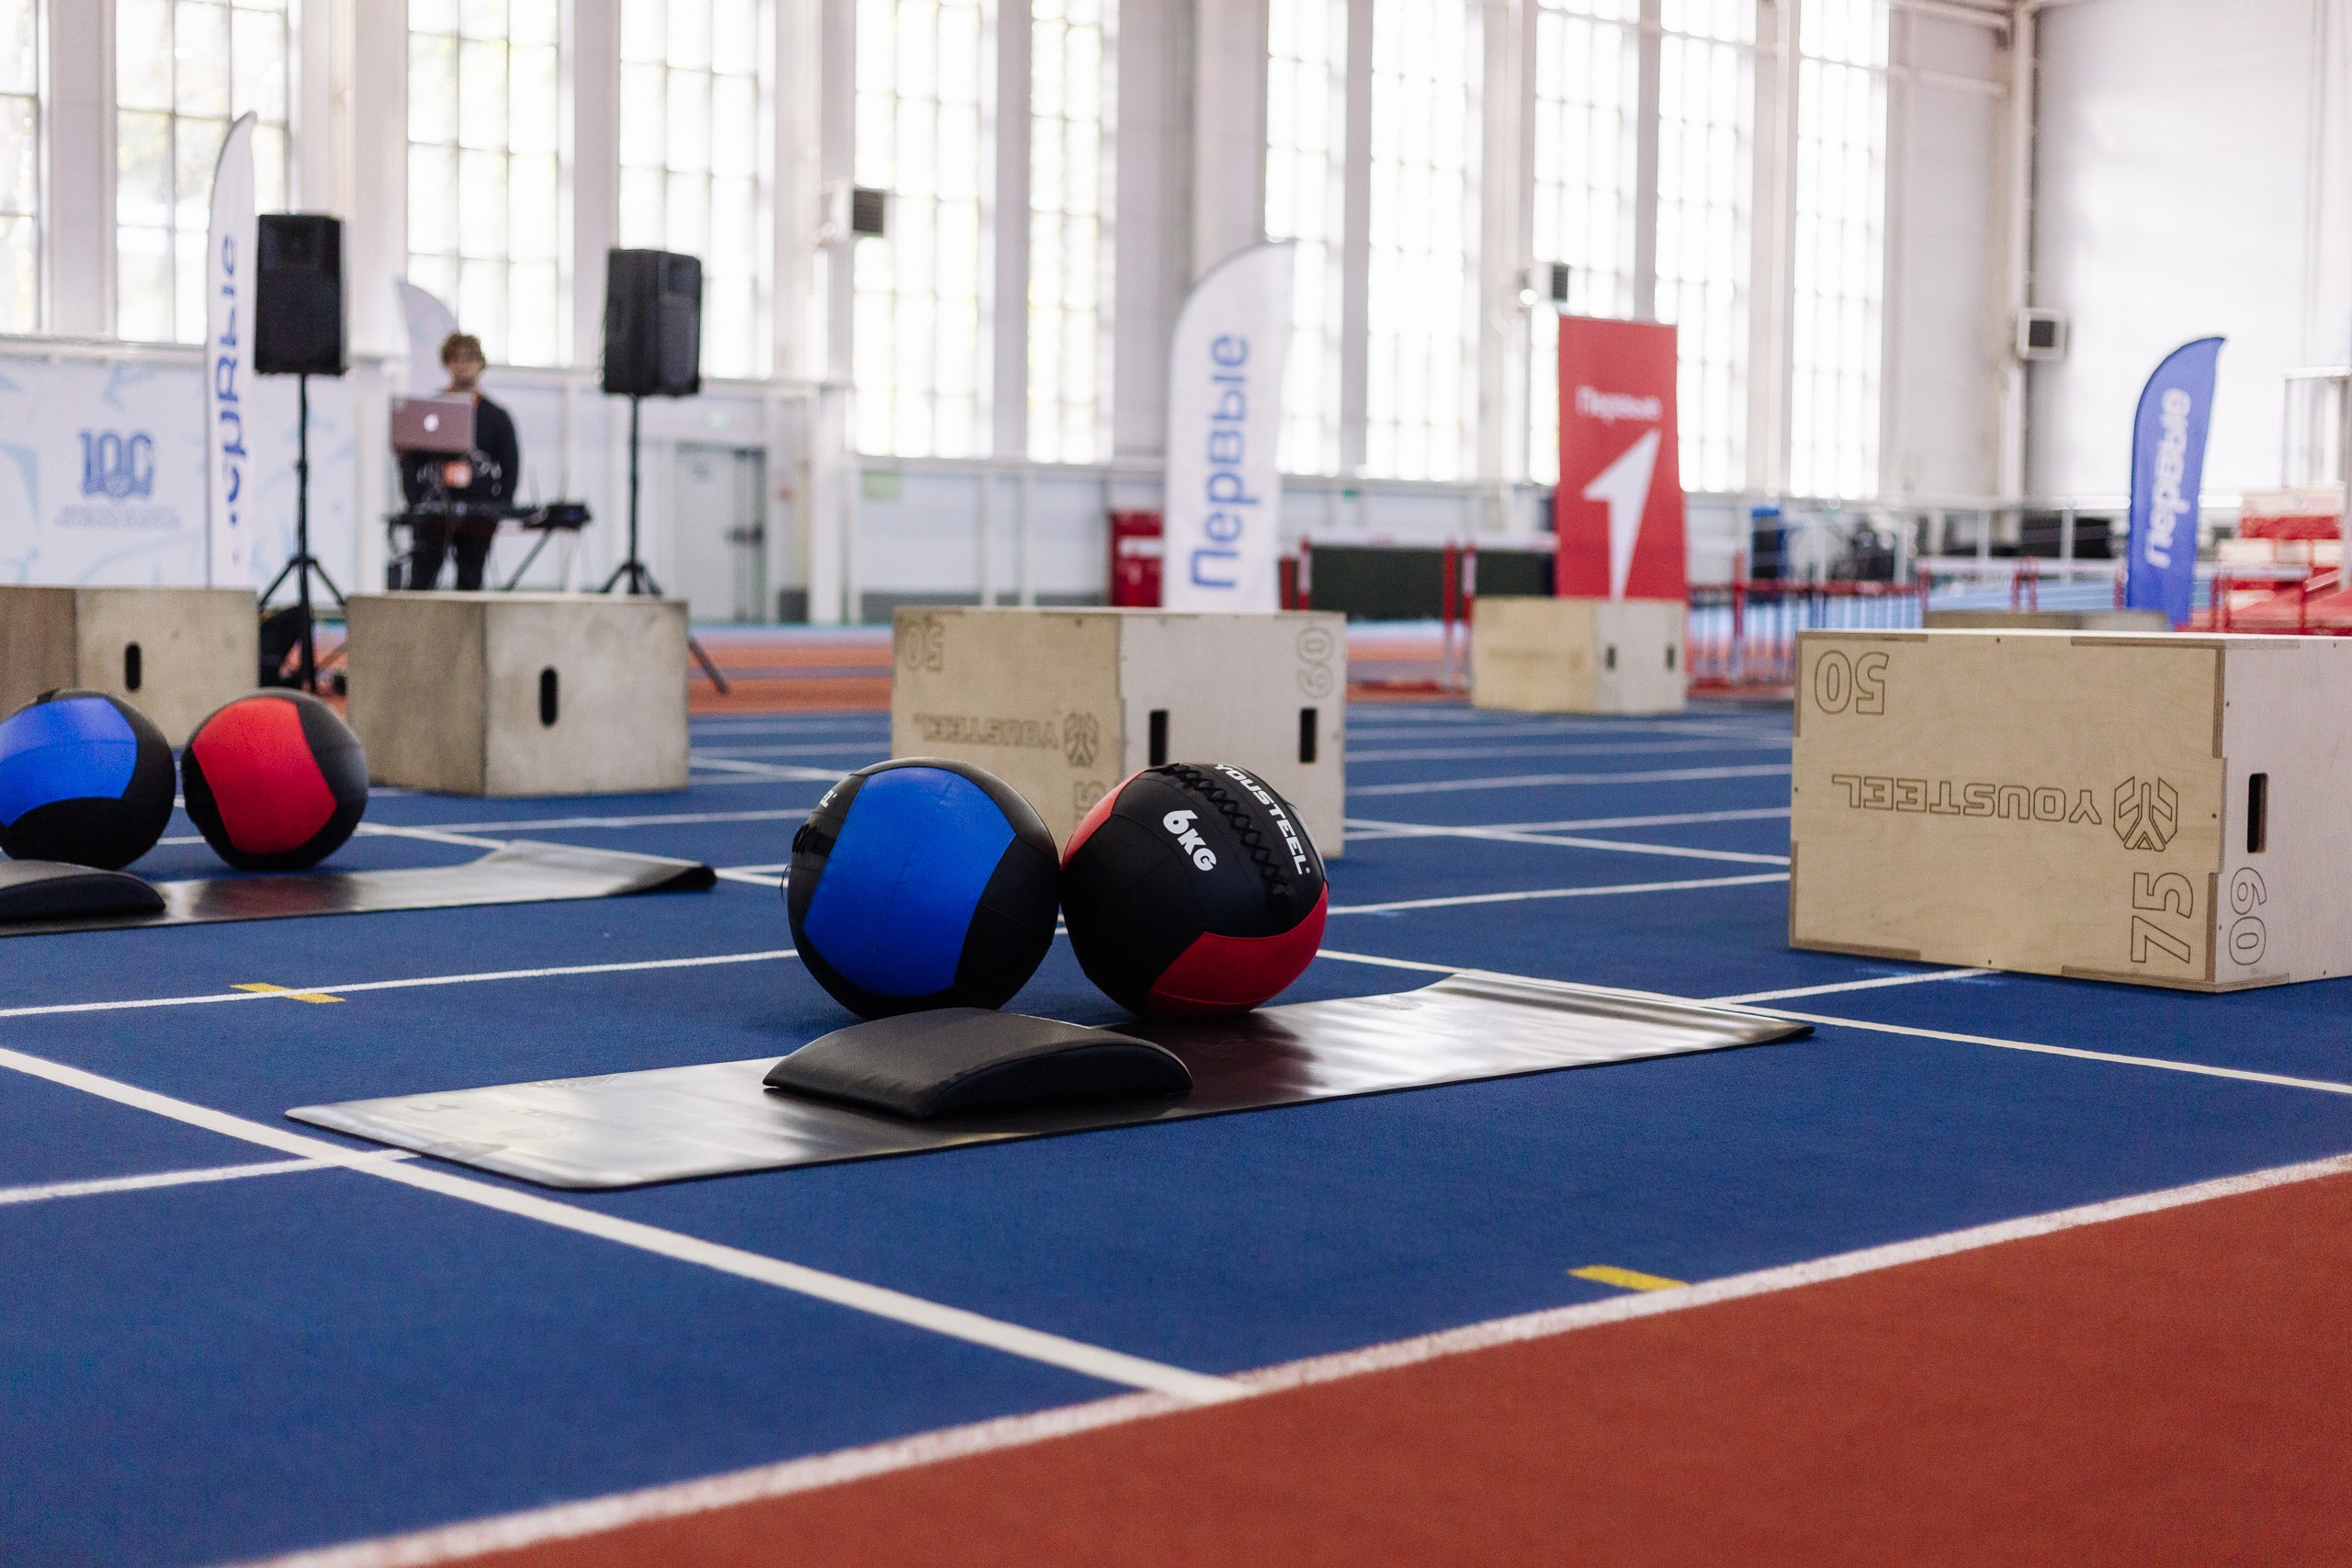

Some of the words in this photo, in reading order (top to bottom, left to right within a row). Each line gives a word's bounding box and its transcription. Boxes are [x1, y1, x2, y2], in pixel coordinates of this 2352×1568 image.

[1189, 335, 1260, 588] Первые
[2143, 387, 2192, 570] Первые
[1815, 649, 1890, 716] 50
[1214, 763, 1311, 875] YOUSTEEL
[1831, 773, 2103, 825] YOUSTEEL
[2130, 872, 2194, 964] 75
[2228, 866, 2267, 966] 60
